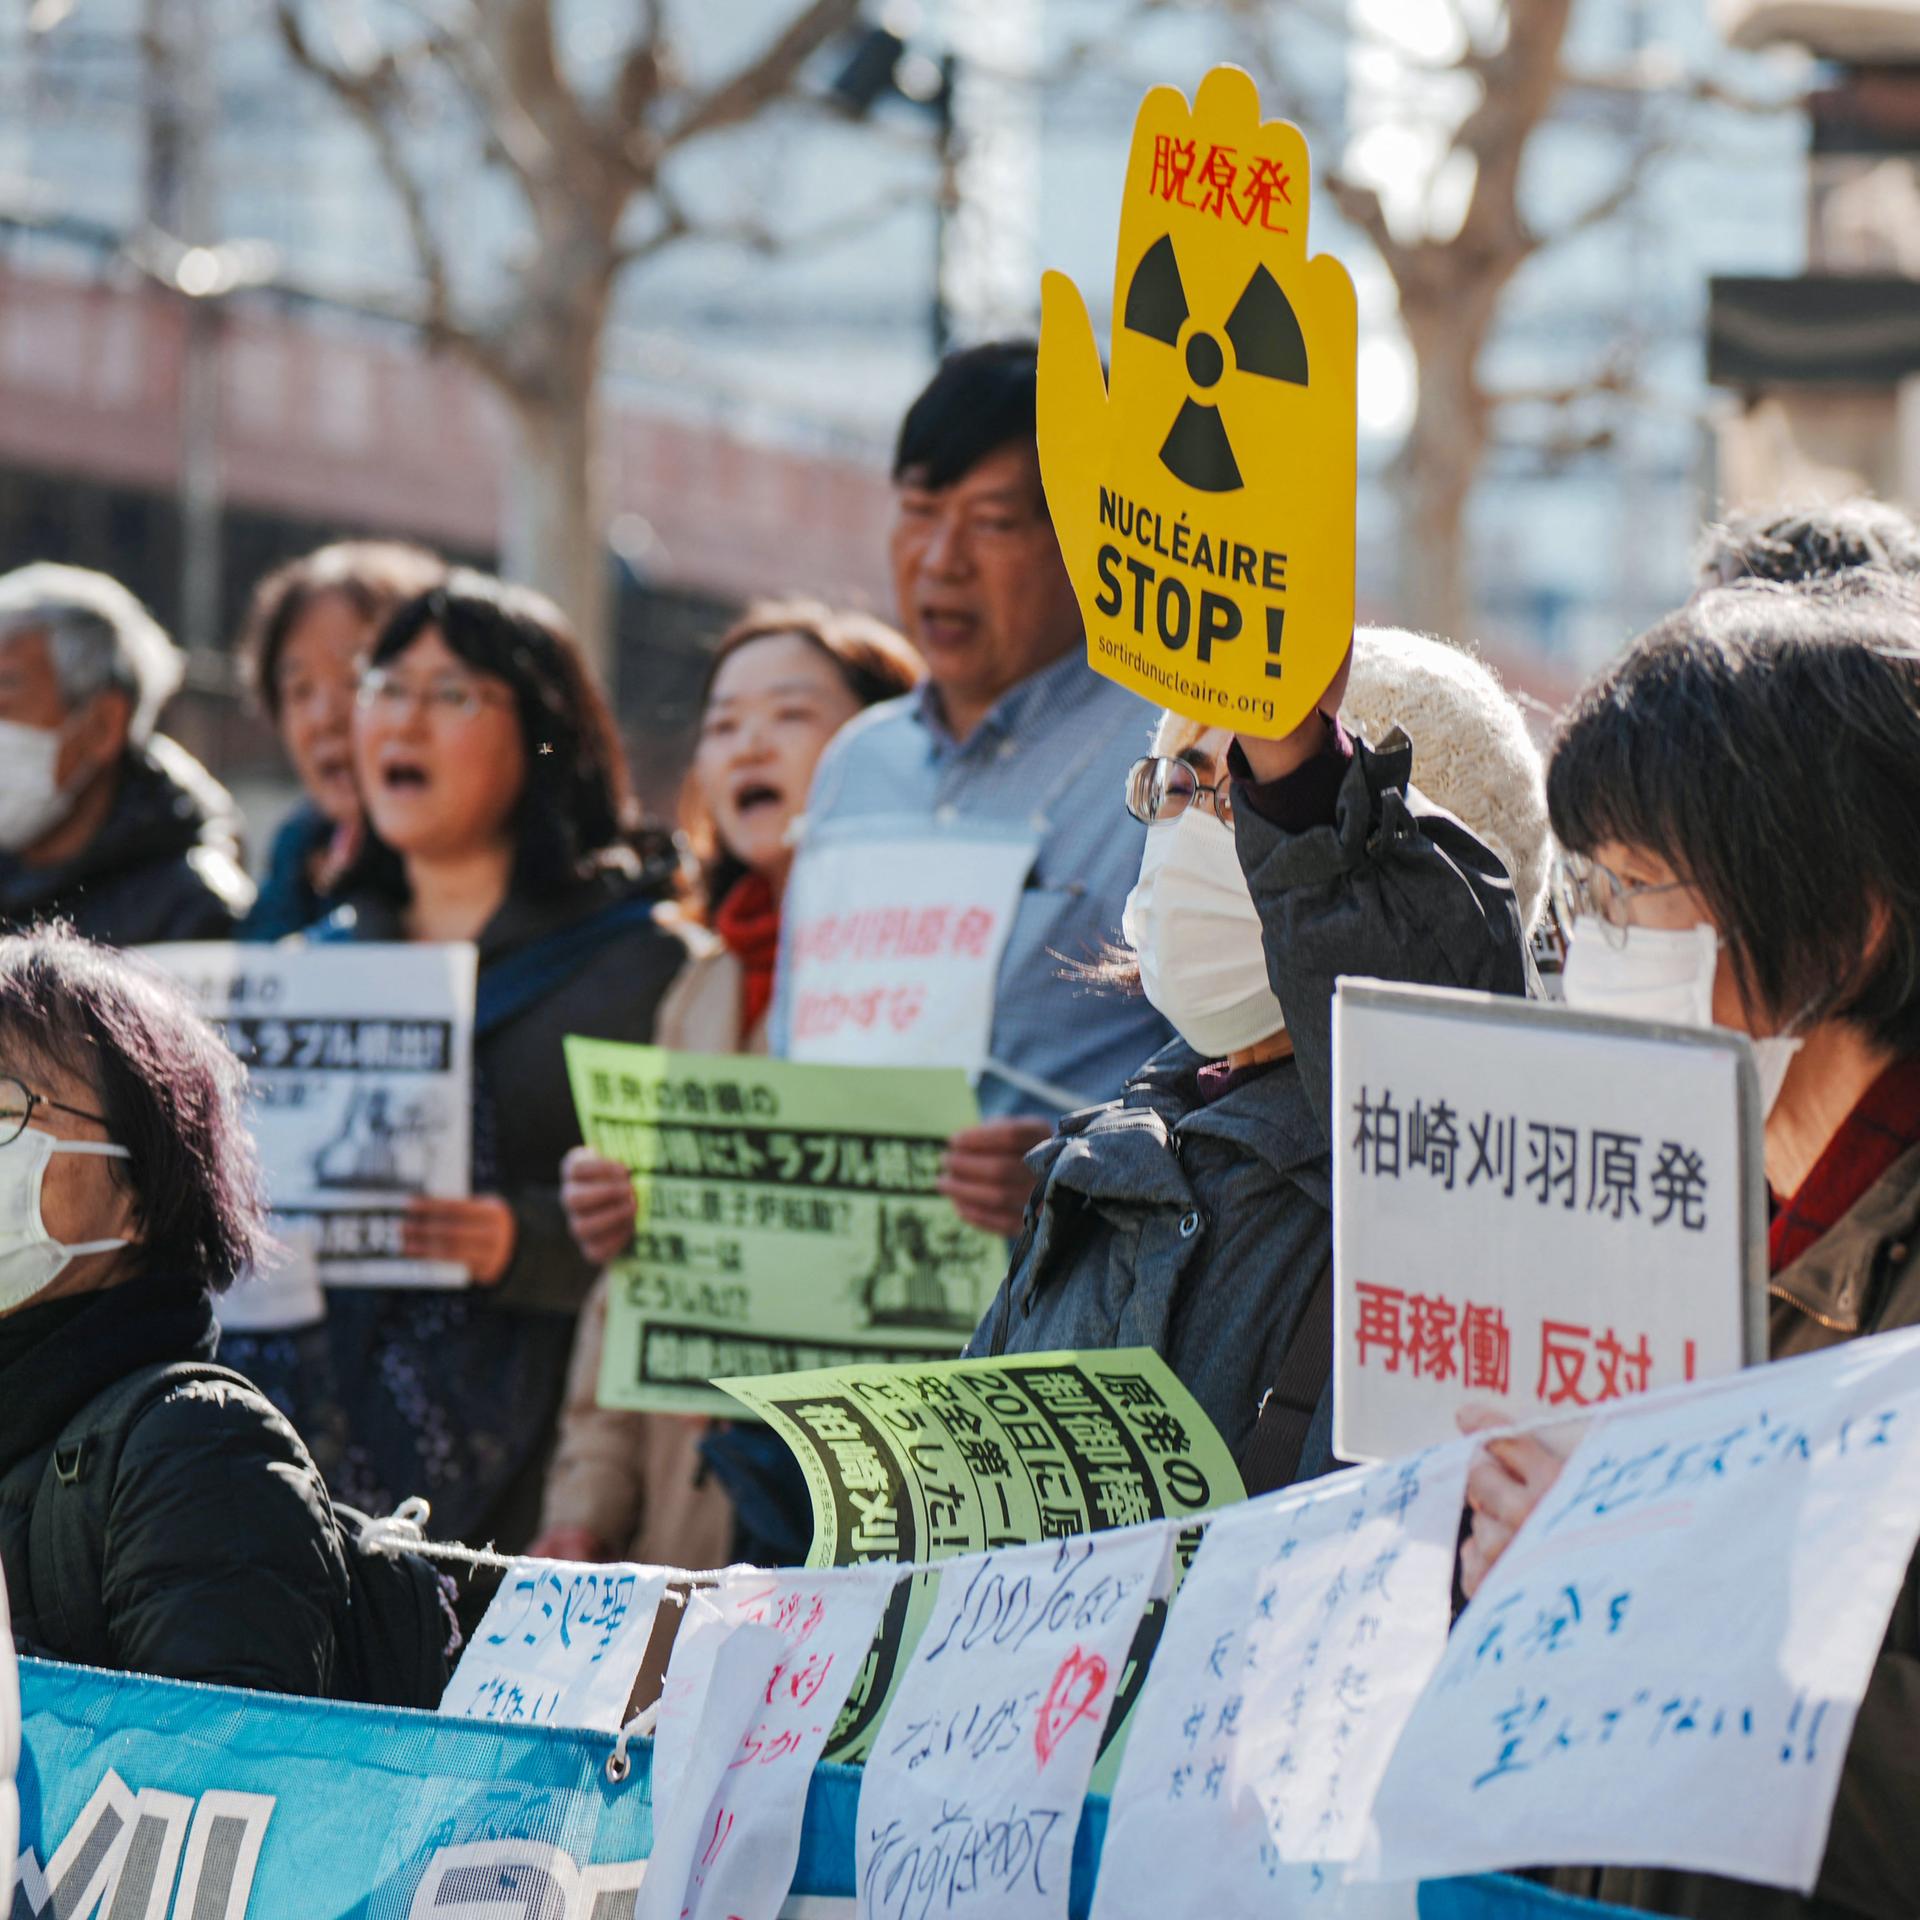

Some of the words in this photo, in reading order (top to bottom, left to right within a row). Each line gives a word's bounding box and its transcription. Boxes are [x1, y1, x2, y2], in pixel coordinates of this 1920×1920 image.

[1150, 134, 1291, 234] 脱原発
[1099, 485, 1287, 592] NUCLÉAIRE
[1095, 544, 1242, 665] STOP
[1264, 606, 1285, 680] !
[1098, 634, 1275, 721] sortirdunucleaire.org
[1352, 1086, 1707, 1231] 柏崎刈羽原発
[1355, 1281, 1509, 1396] 再稼働
[851, 1382, 970, 1556] どうした!
